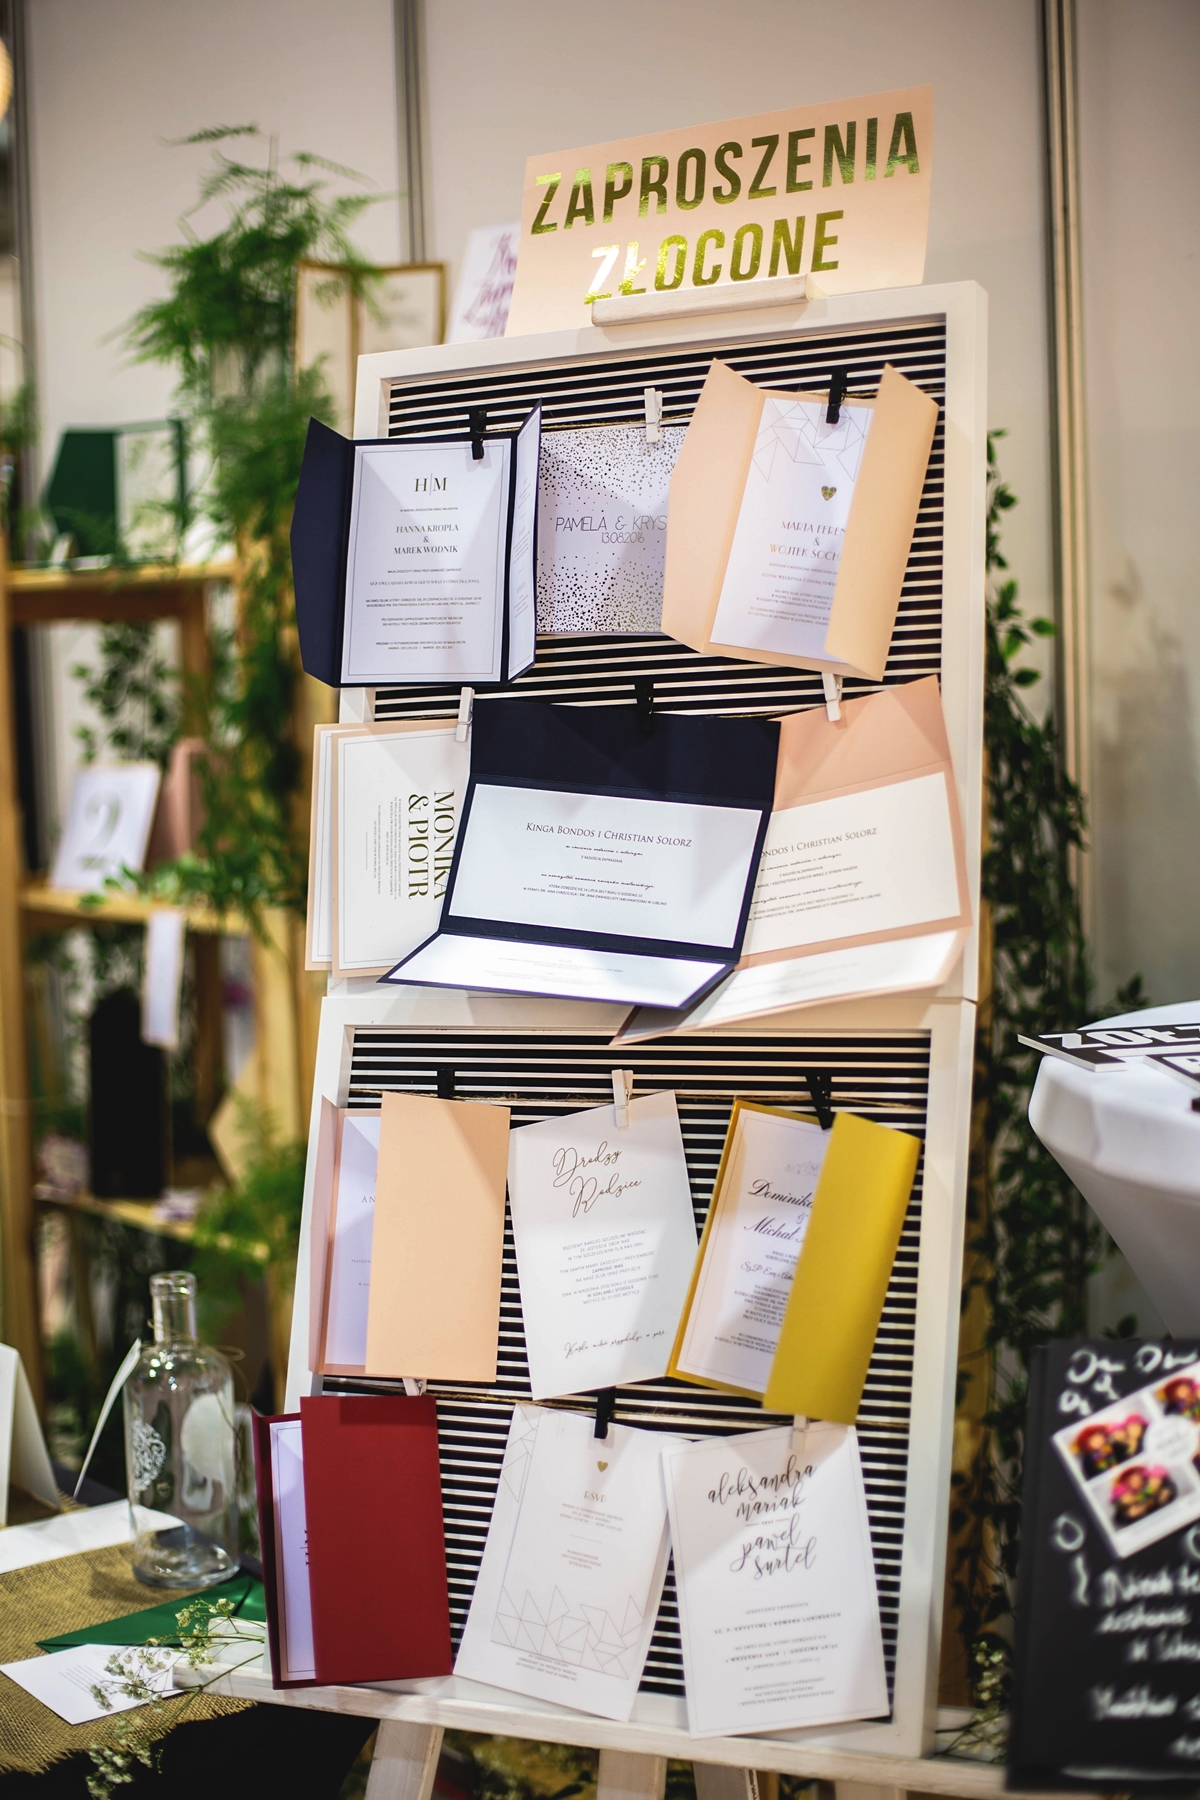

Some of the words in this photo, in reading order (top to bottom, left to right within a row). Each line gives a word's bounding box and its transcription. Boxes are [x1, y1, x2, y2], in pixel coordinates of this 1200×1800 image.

[531, 111, 920, 235] ZAPROSZENIA
[584, 210, 844, 304] ZŁOCONE
[396, 525, 426, 534] HANNA
[555, 516, 607, 531] PAMELA
[615, 515, 627, 531] &
[781, 521, 814, 533] MARTA
[394, 546, 422, 555] MAREK
[423, 545, 458, 554] WODNIK
[770, 544, 808, 557] WOJTEK
[408, 793, 429, 813] &
[408, 818, 429, 899] PIOTR
[434, 789, 455, 900] MONIKA
[553, 1141, 622, 1187] Drodzy
[569, 1172, 642, 1218] Rodzice
[708, 1454, 817, 1505] aleksandra
